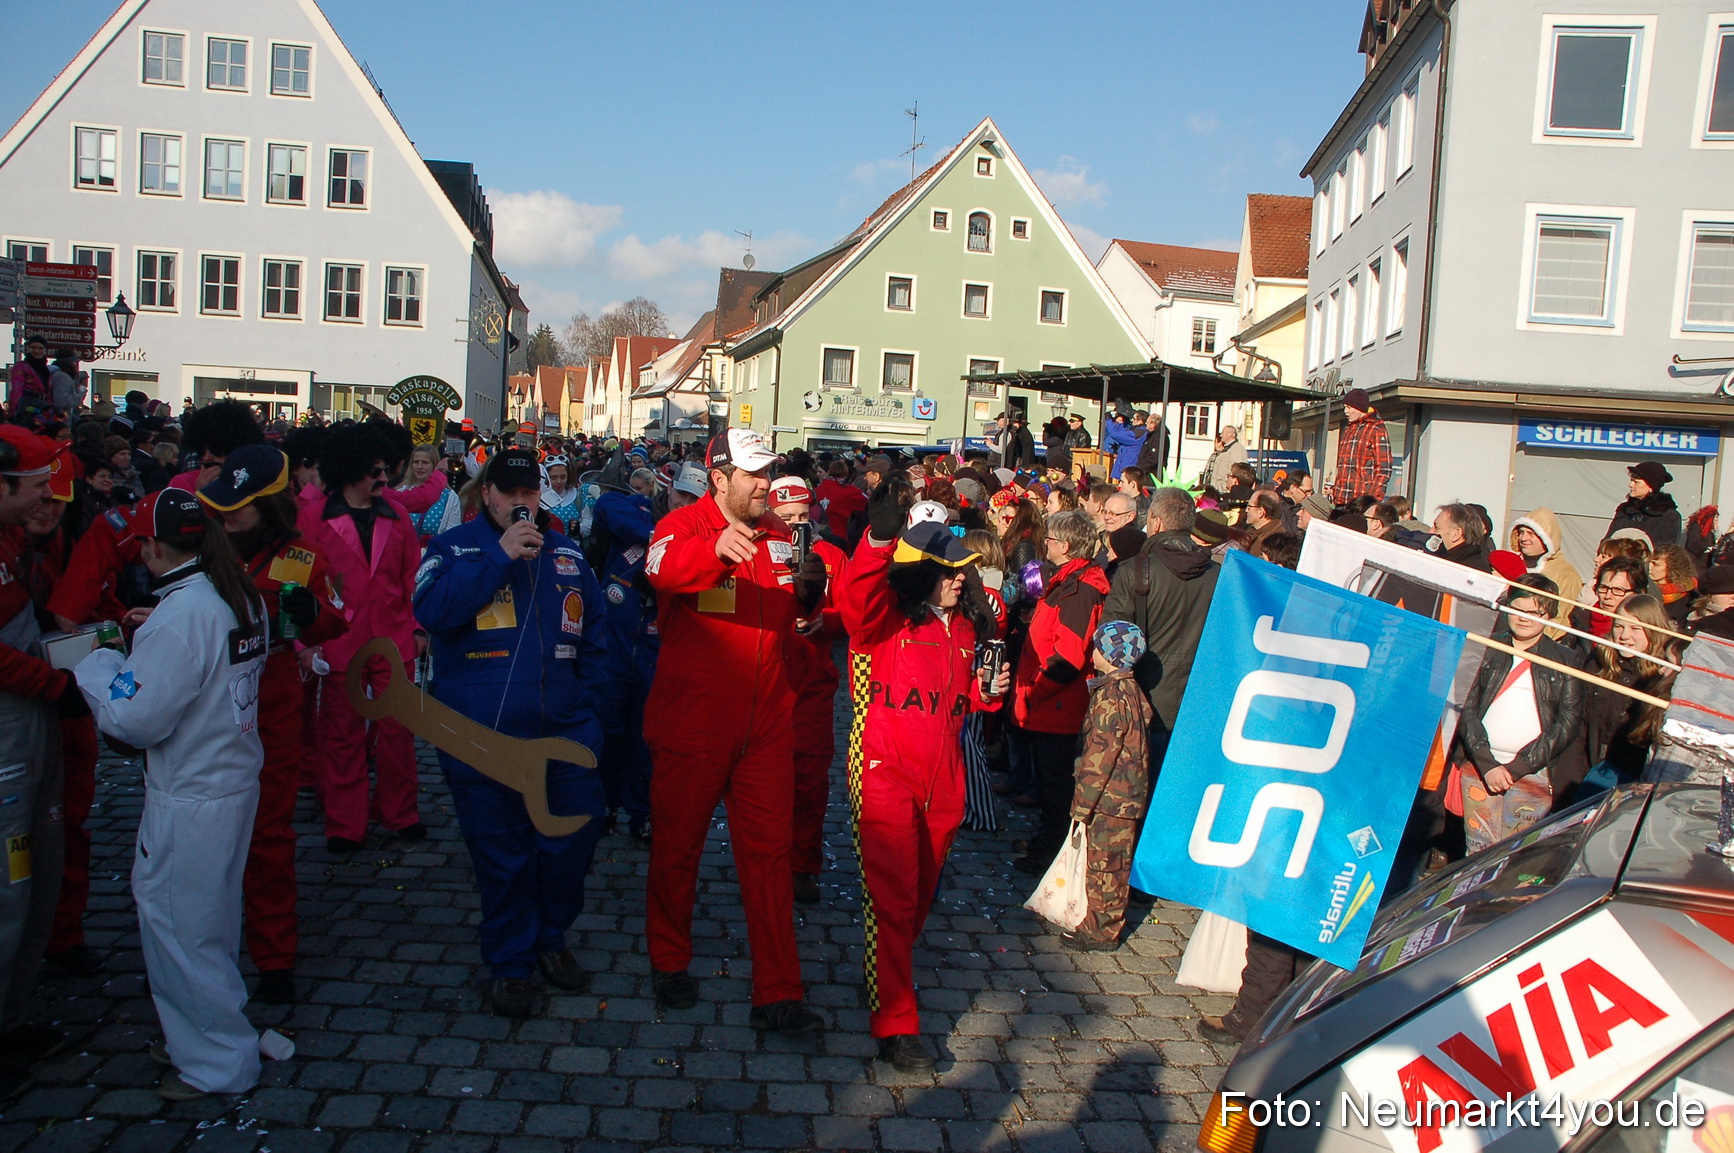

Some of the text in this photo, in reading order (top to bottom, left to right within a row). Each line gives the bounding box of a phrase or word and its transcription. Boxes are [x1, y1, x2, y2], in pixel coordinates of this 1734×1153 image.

[27, 265, 75, 275] Tourist-Information
[26, 298, 75, 309] hist. Vorstadt
[26, 314, 80, 325] Heimatmuseum
[26, 329, 82, 341] Stadtpfarrkirche
[388, 378, 458, 406] Blaskapelle
[402, 393, 445, 413] Pilsach
[416, 406, 433, 415] 1954
[830, 403, 906, 418] HINTERMEYER
[1535, 423, 1699, 450] SCHLECKER
[712, 453, 728, 464] DTM
[495, 591, 512, 604] AC
[608, 587, 623, 601] Esso
[113, 677, 132, 695] ARAL
[869, 680, 941, 715] PLAY
